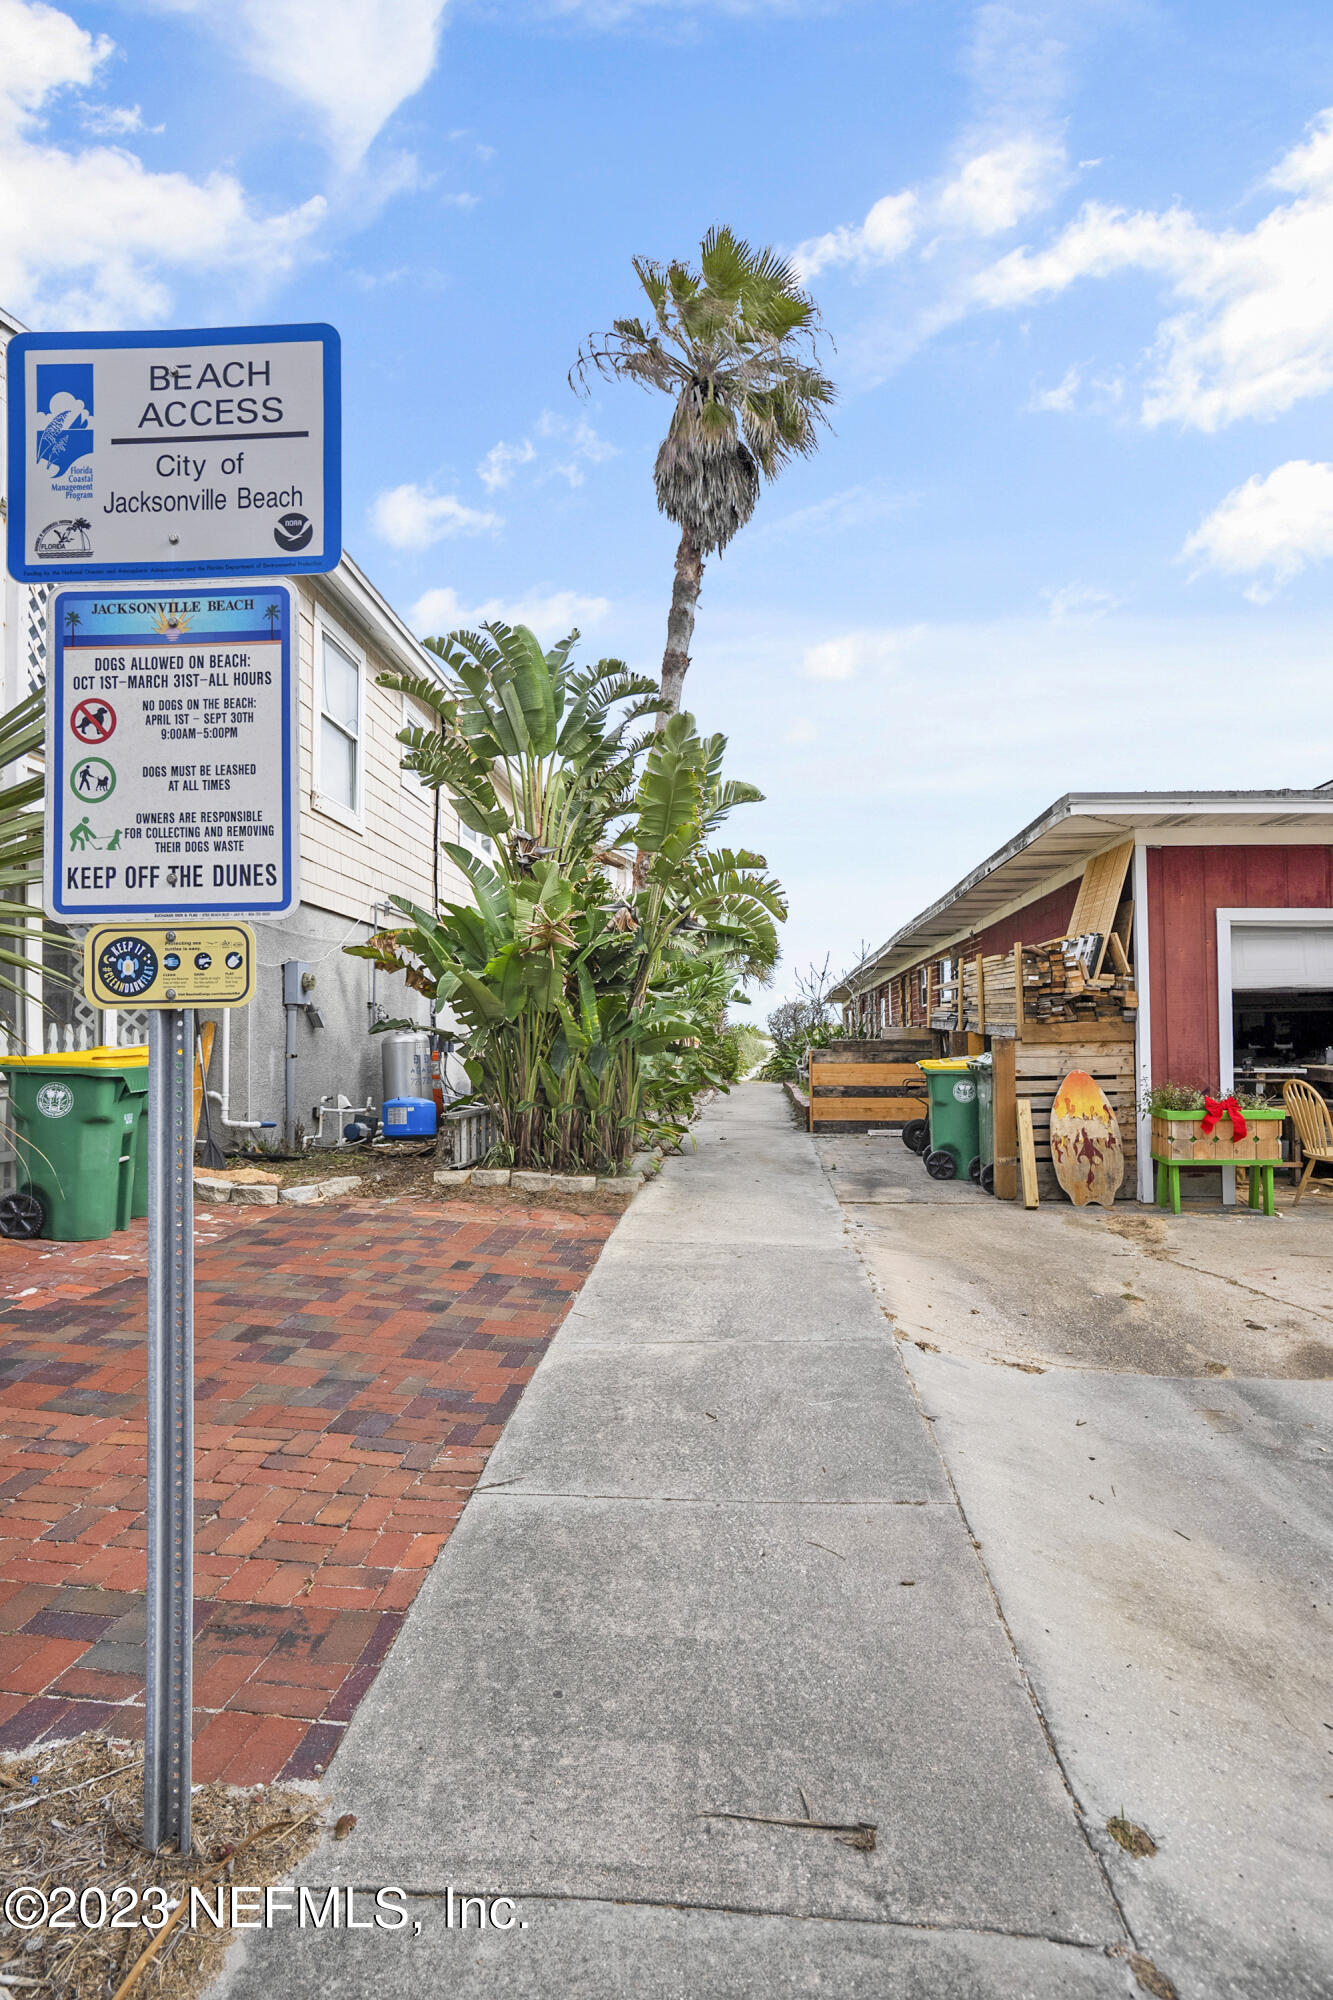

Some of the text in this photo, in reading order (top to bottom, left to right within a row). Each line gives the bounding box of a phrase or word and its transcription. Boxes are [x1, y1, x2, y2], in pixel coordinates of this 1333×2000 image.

[150, 361, 270, 391] BEACH
[137, 397, 283, 428] ACCESS
[156, 452, 244, 482] City of
[51, 484, 93, 492] Management
[66, 492, 93, 501] Program
[104, 486, 302, 513] Jacksonville Beach
[92, 599, 254, 615] JACKSONVILLE BEACH
[94, 654, 250, 672] DOGS ALLOWED ON BEACH:
[74, 676, 96, 690] OCT
[234, 670, 272, 686] HOURS
[142, 698, 256, 712] NO DOGS ON THE BEACH:
[146, 714, 170, 726] APRIL
[174, 714, 190, 724] 1ST
[204, 712, 228, 724] SEPT
[230, 712, 254, 724] 30TH
[142, 764, 256, 778] DOGS MUST BE LEASHED
[168, 778, 230, 792] AT ALL TIMES
[136, 810, 262, 824] OWNERS ARE RESPONSIBLE
[124, 824, 274, 838] FOR COLLECTING AND REMOVING
[154, 840, 244, 852] THEIR DOGS WASTE
[68, 864, 276, 890] KEEP OFF THE DUNES
[111, 941, 146, 956] KEEP IT
